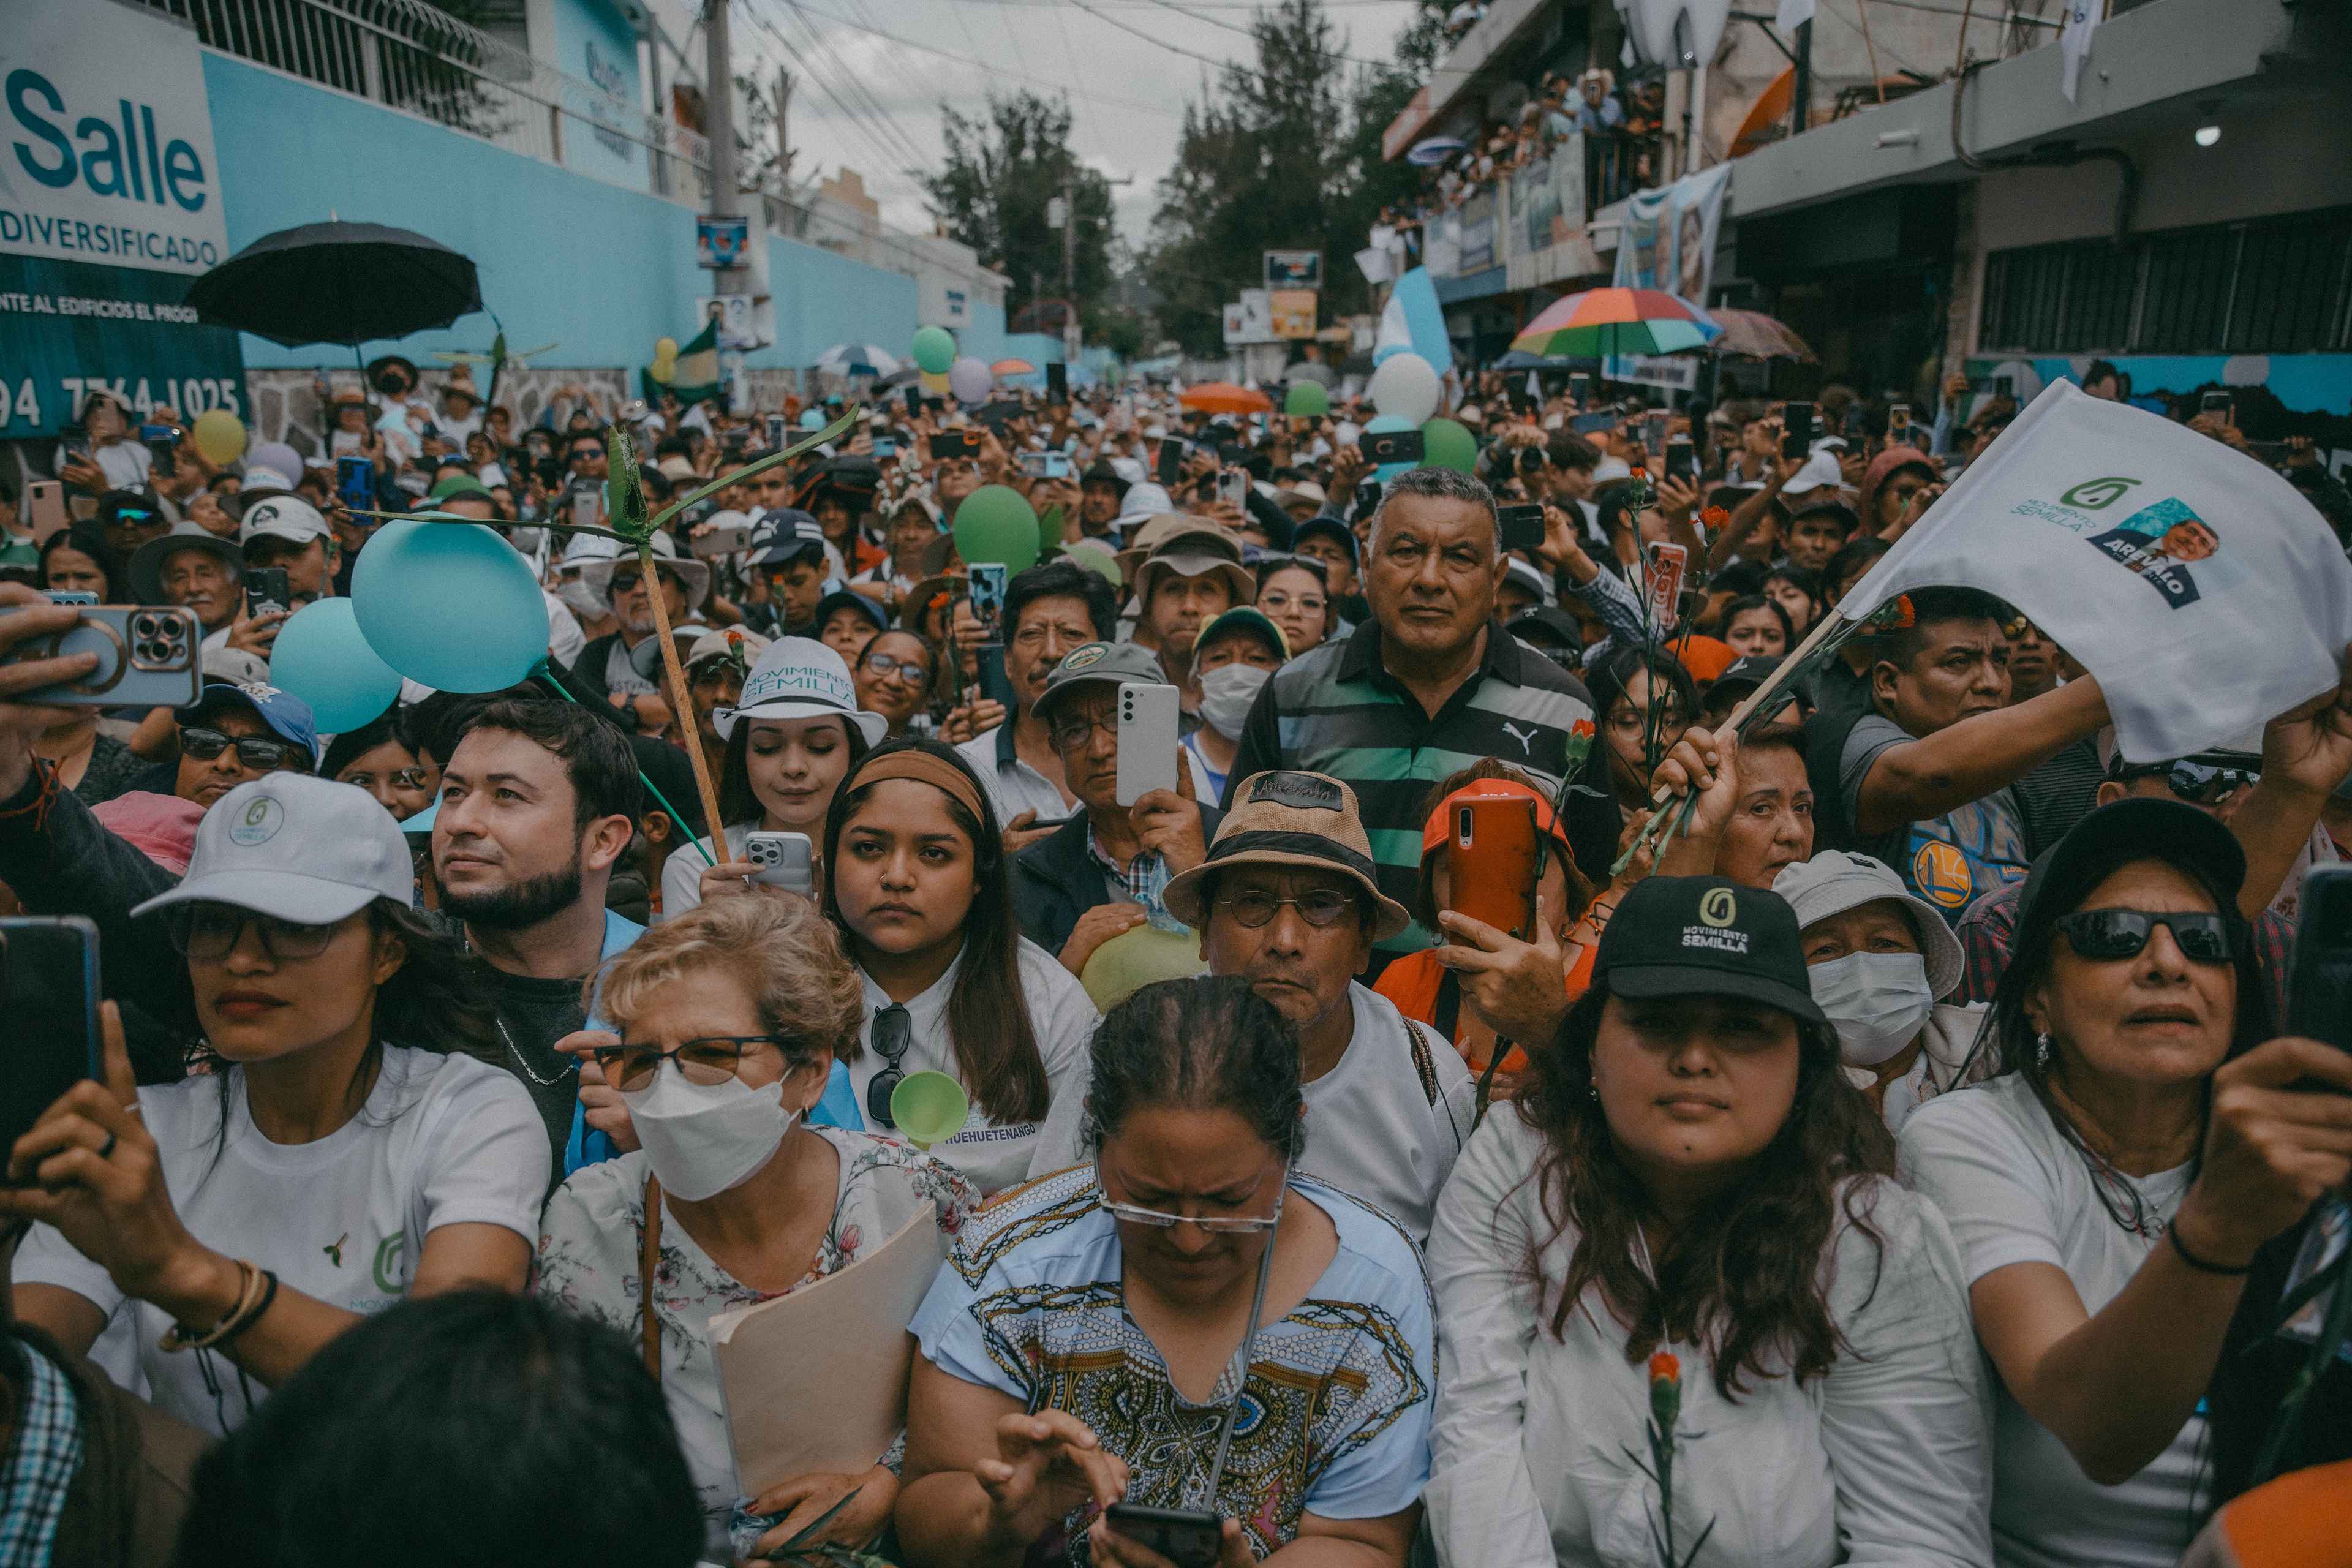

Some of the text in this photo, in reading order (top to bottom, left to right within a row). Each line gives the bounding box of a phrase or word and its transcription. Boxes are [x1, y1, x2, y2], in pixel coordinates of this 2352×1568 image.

[6, 68, 206, 212] Salle
[0, 210, 217, 267] DIVERSIFICADO
[32, 294, 57, 314] AL
[2011, 505, 2082, 532] SEMILLA
[2103, 539, 2184, 594] AREVALO
[745, 677, 856, 708] SEMILLA
[746, 667, 854, 695] MOVIMIENTO
[1681, 934, 1748, 954] SEMILLA
[1683, 926, 1749, 943] MOVIMIENTO
